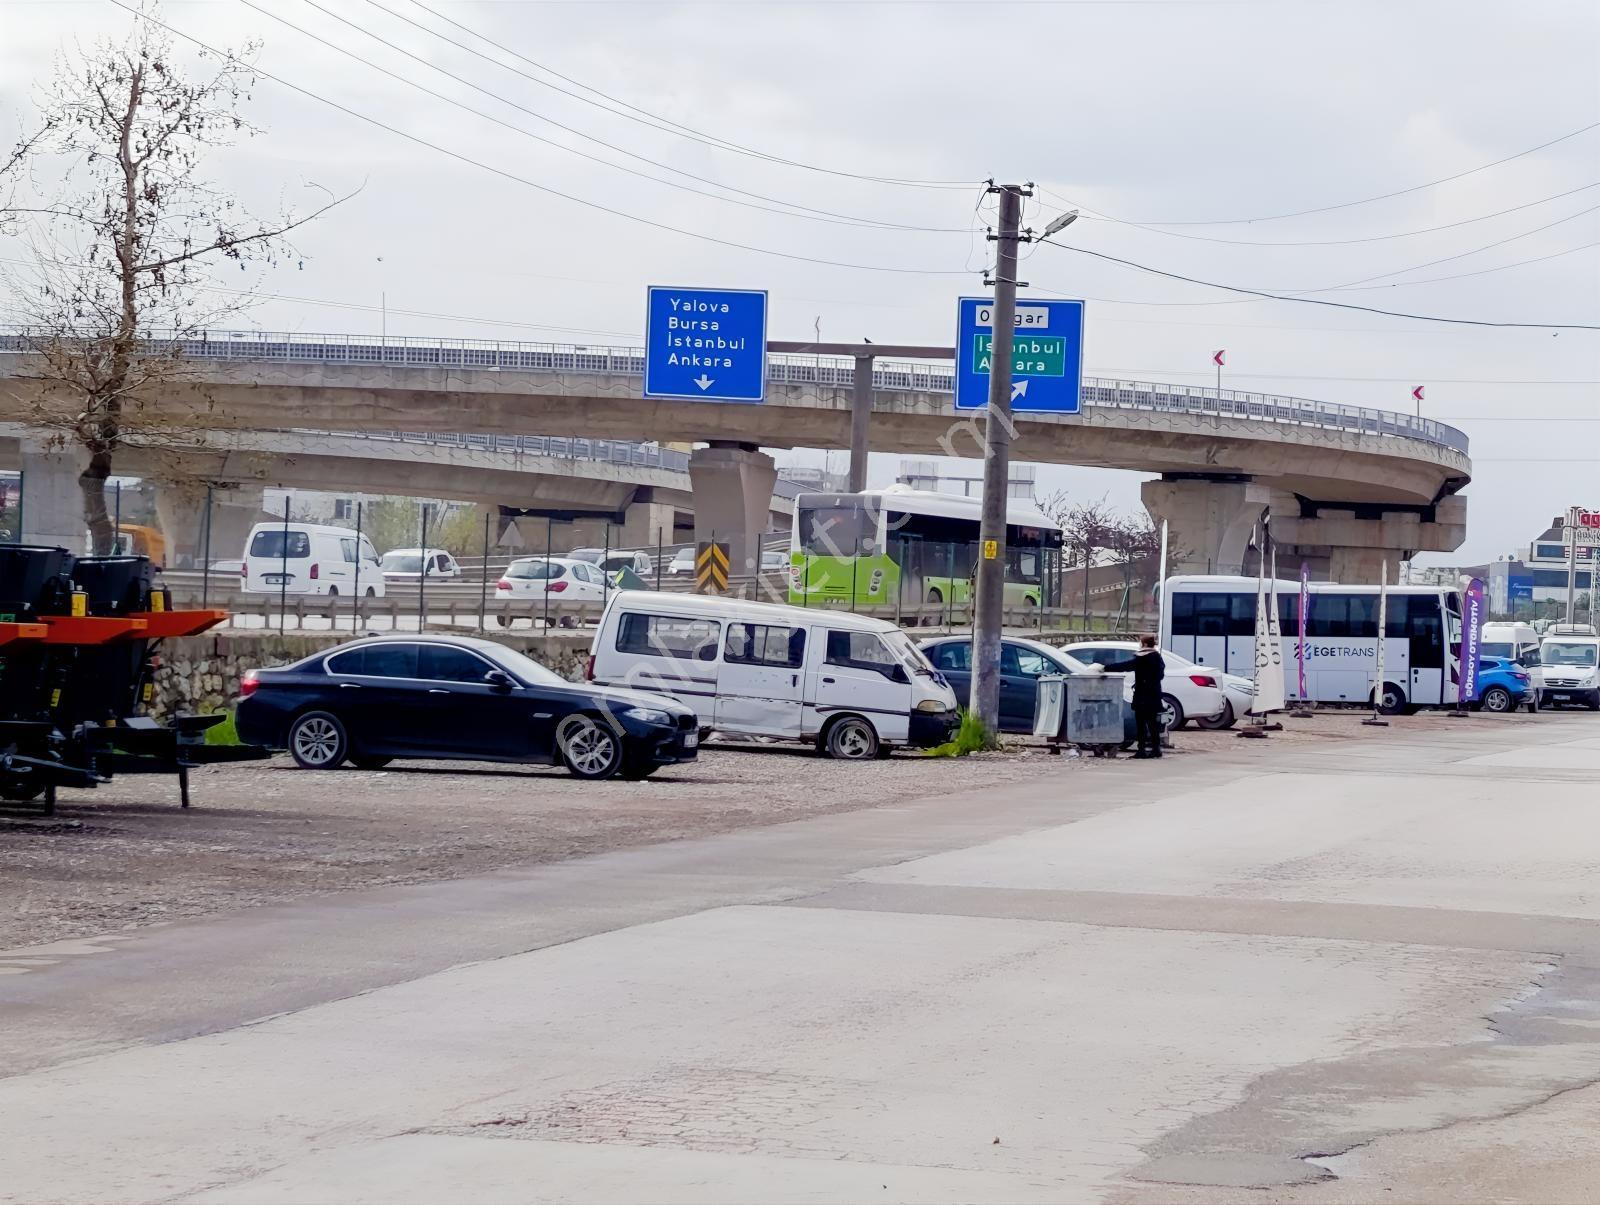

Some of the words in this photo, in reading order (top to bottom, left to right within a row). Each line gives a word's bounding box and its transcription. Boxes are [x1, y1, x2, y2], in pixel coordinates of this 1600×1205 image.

[670, 298, 729, 313] Yalova
[668, 316, 719, 331] Bursa
[980, 309, 1044, 327] Ogar
[668, 332, 745, 350] İstanbul
[668, 353, 732, 368] Ankara
[978, 357, 1045, 371] Aara
[1313, 646, 1375, 658] EGETRANS
